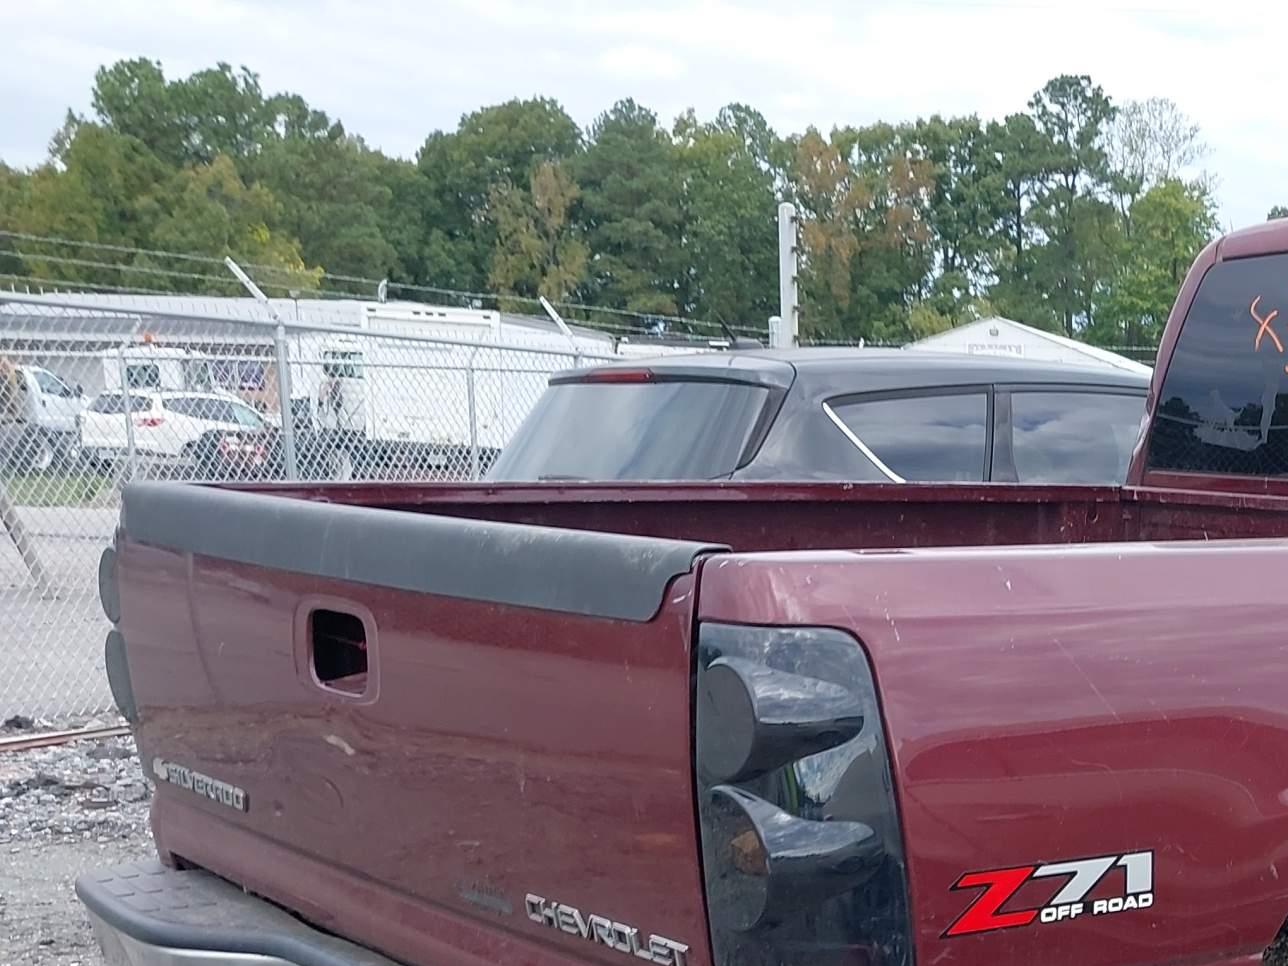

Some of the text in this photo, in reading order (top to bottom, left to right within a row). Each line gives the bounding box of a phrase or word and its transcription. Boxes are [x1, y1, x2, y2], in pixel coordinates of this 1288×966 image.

[941, 850, 1154, 938] Z71
[1039, 892, 1154, 923] OFF ROAD
